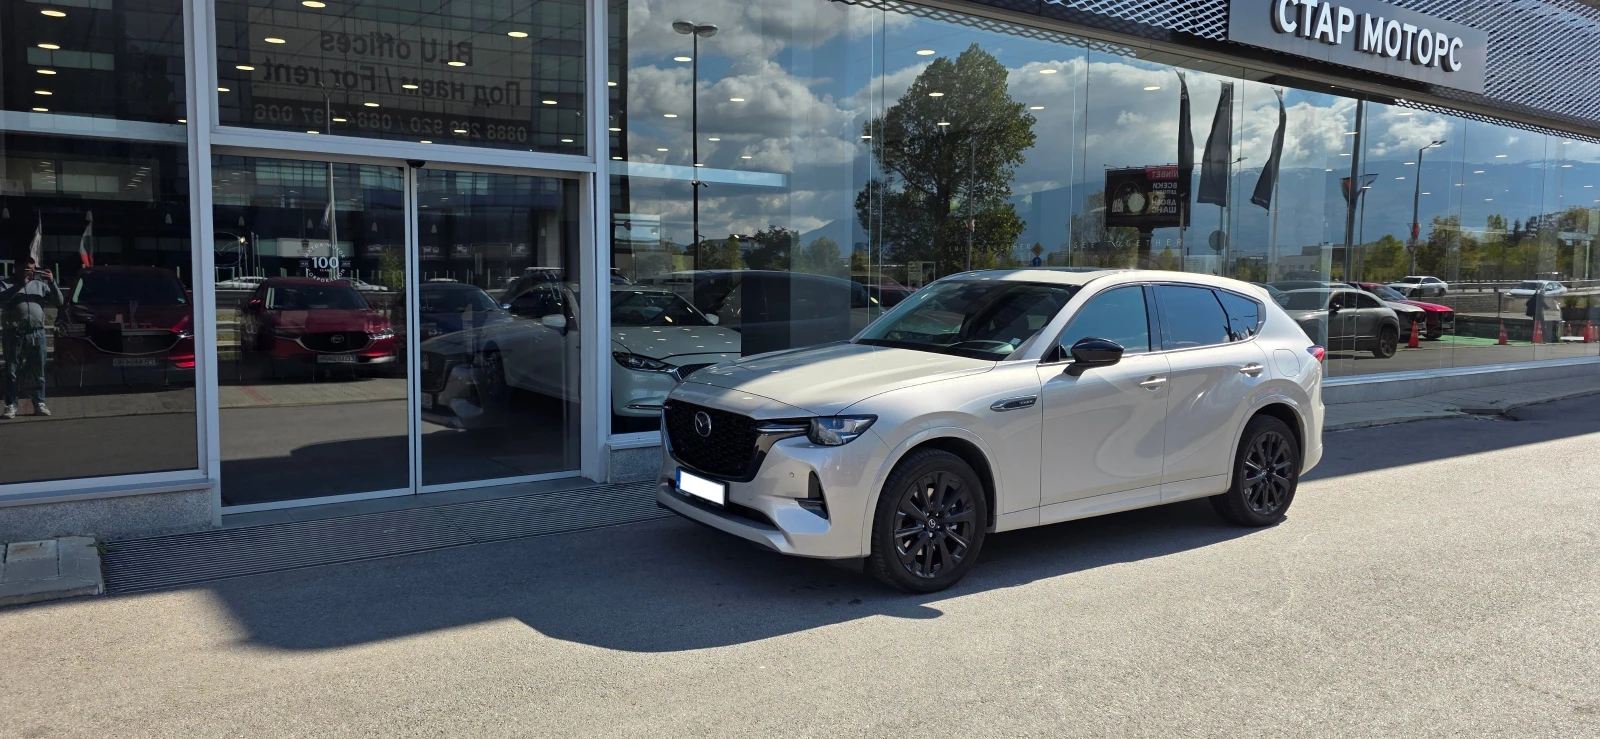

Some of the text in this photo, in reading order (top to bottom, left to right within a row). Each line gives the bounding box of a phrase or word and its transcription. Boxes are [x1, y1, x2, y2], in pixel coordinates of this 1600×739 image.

[1277, 0, 1463, 72] СТАР МОТОРС
[1073, 238, 1183, 249] SEE TOGETHER
[311, 256, 339, 269] 100
